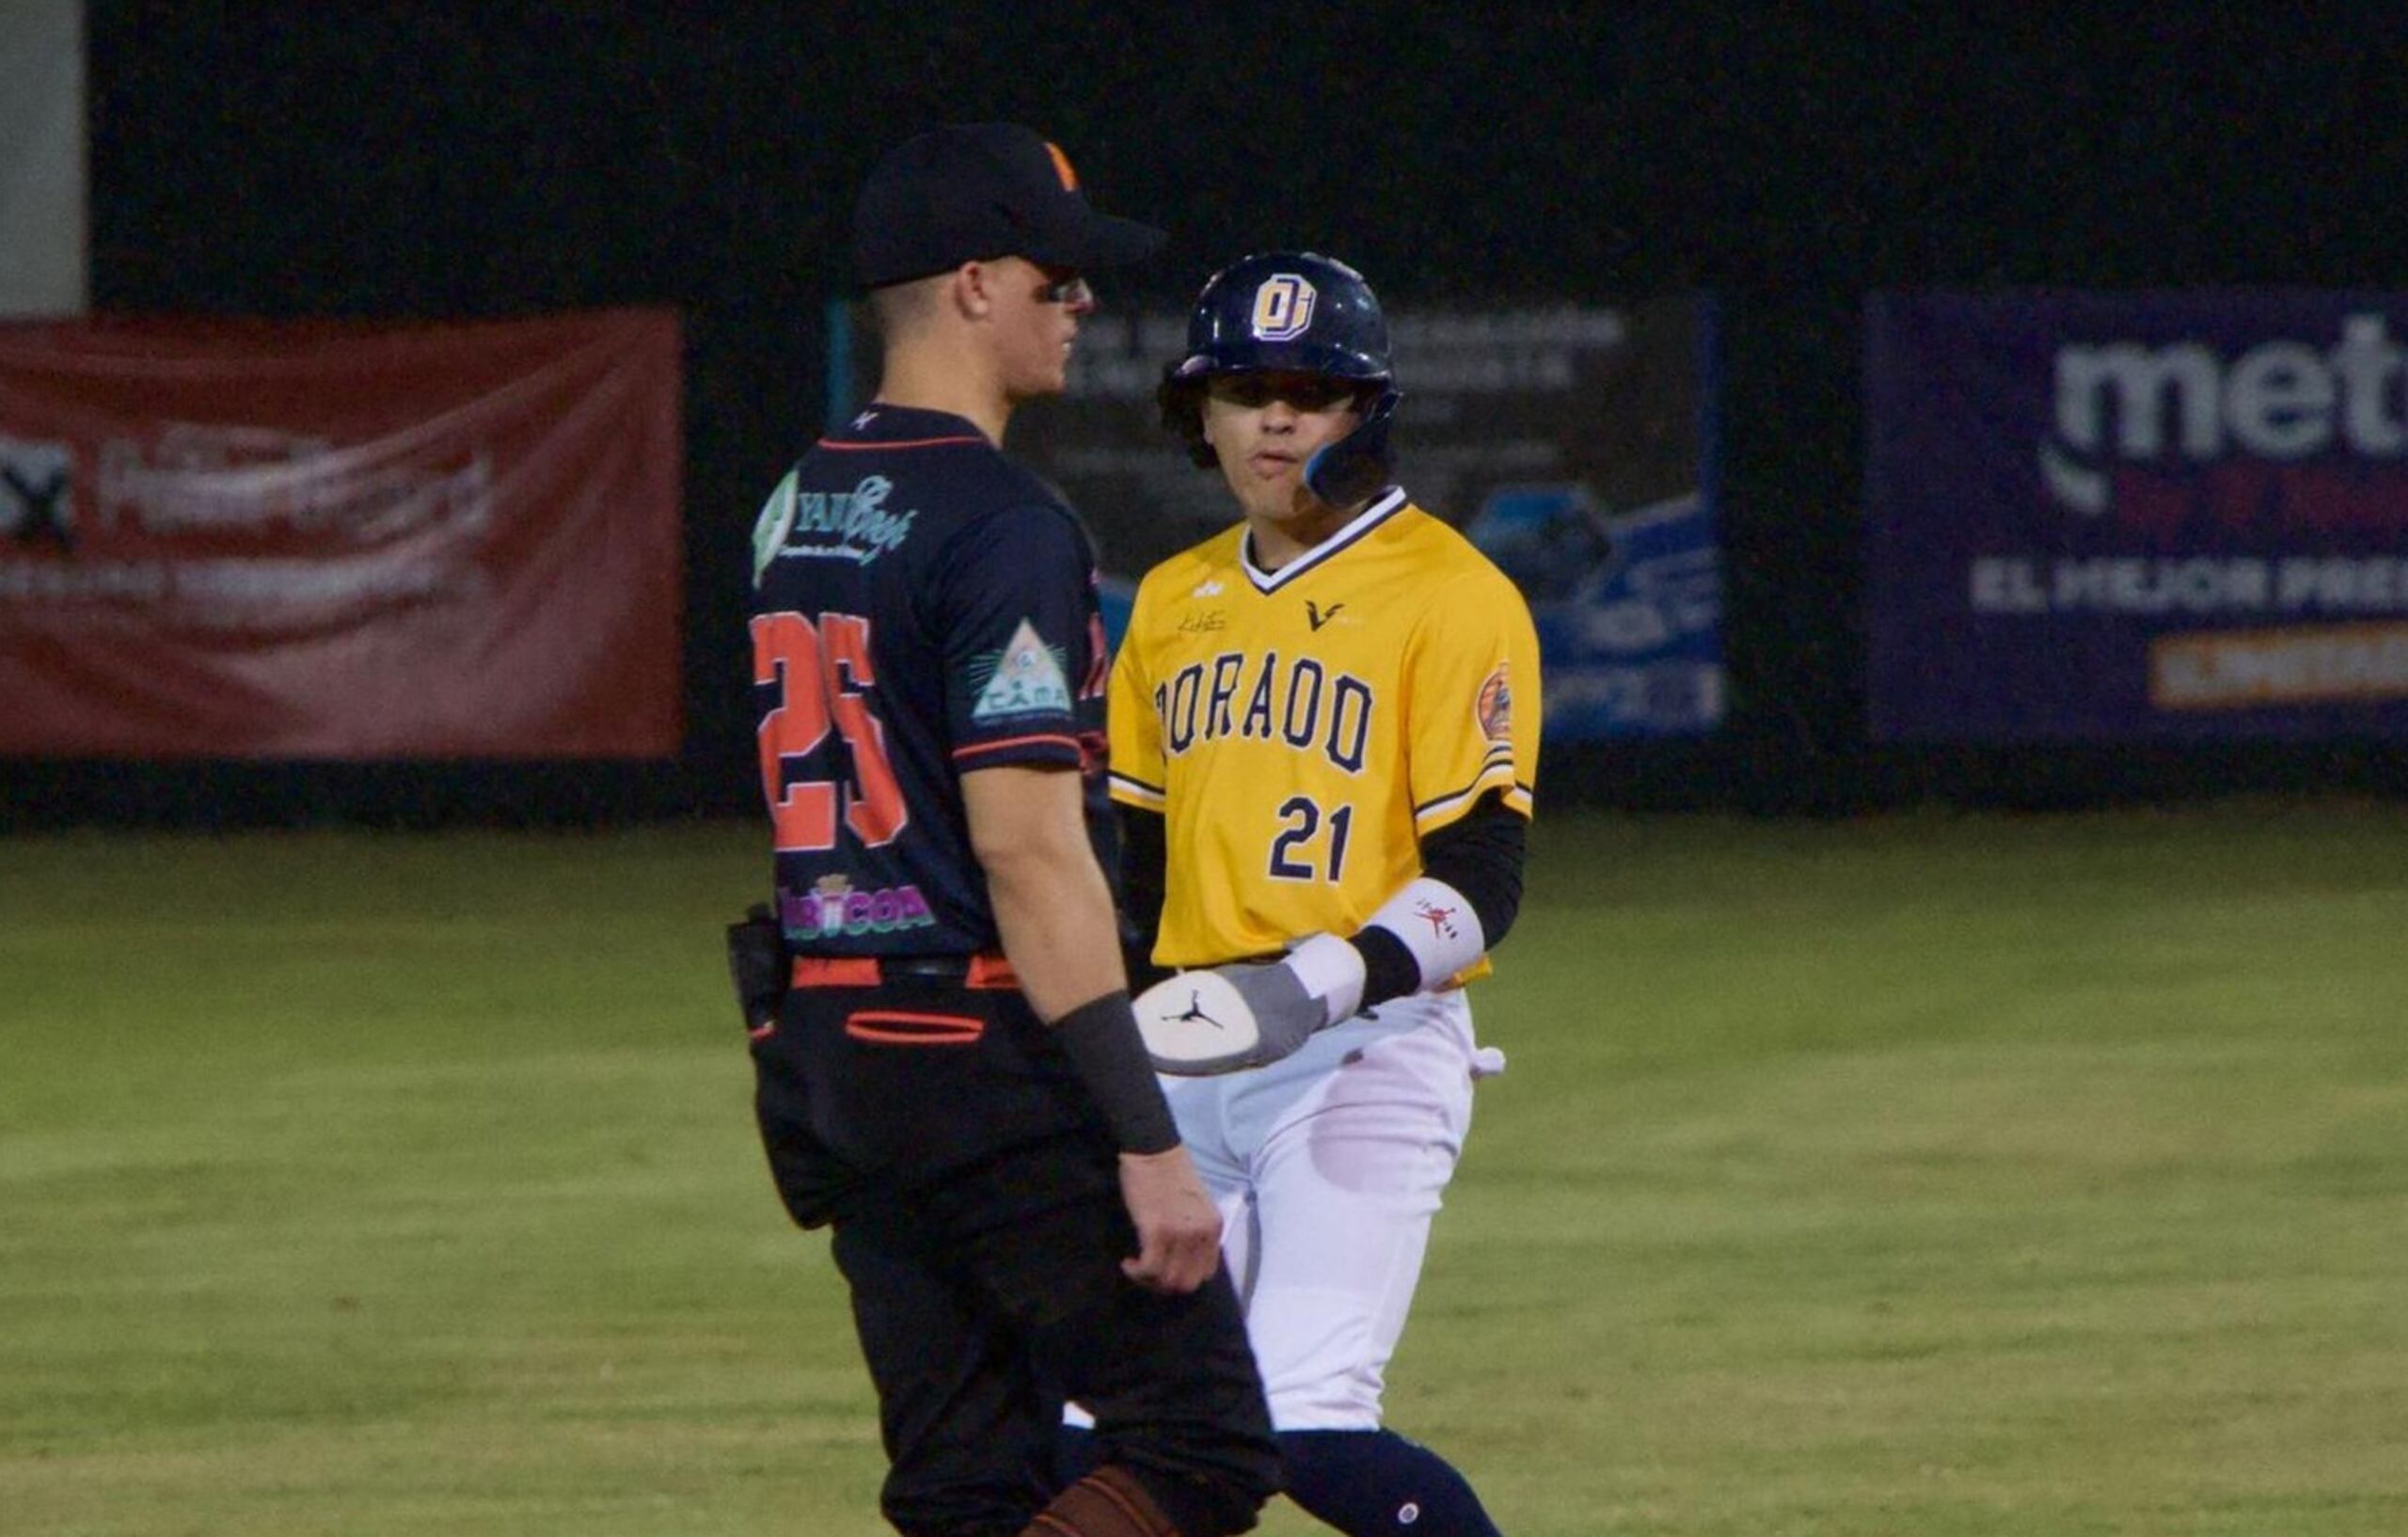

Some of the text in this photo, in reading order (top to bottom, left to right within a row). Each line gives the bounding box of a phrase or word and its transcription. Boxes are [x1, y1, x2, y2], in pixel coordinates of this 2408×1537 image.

[1971, 557, 2047, 613] EL
[2052, 556, 2265, 611] MEJOR
[749, 610, 910, 851] 25
[1268, 795, 1353, 884] 21
